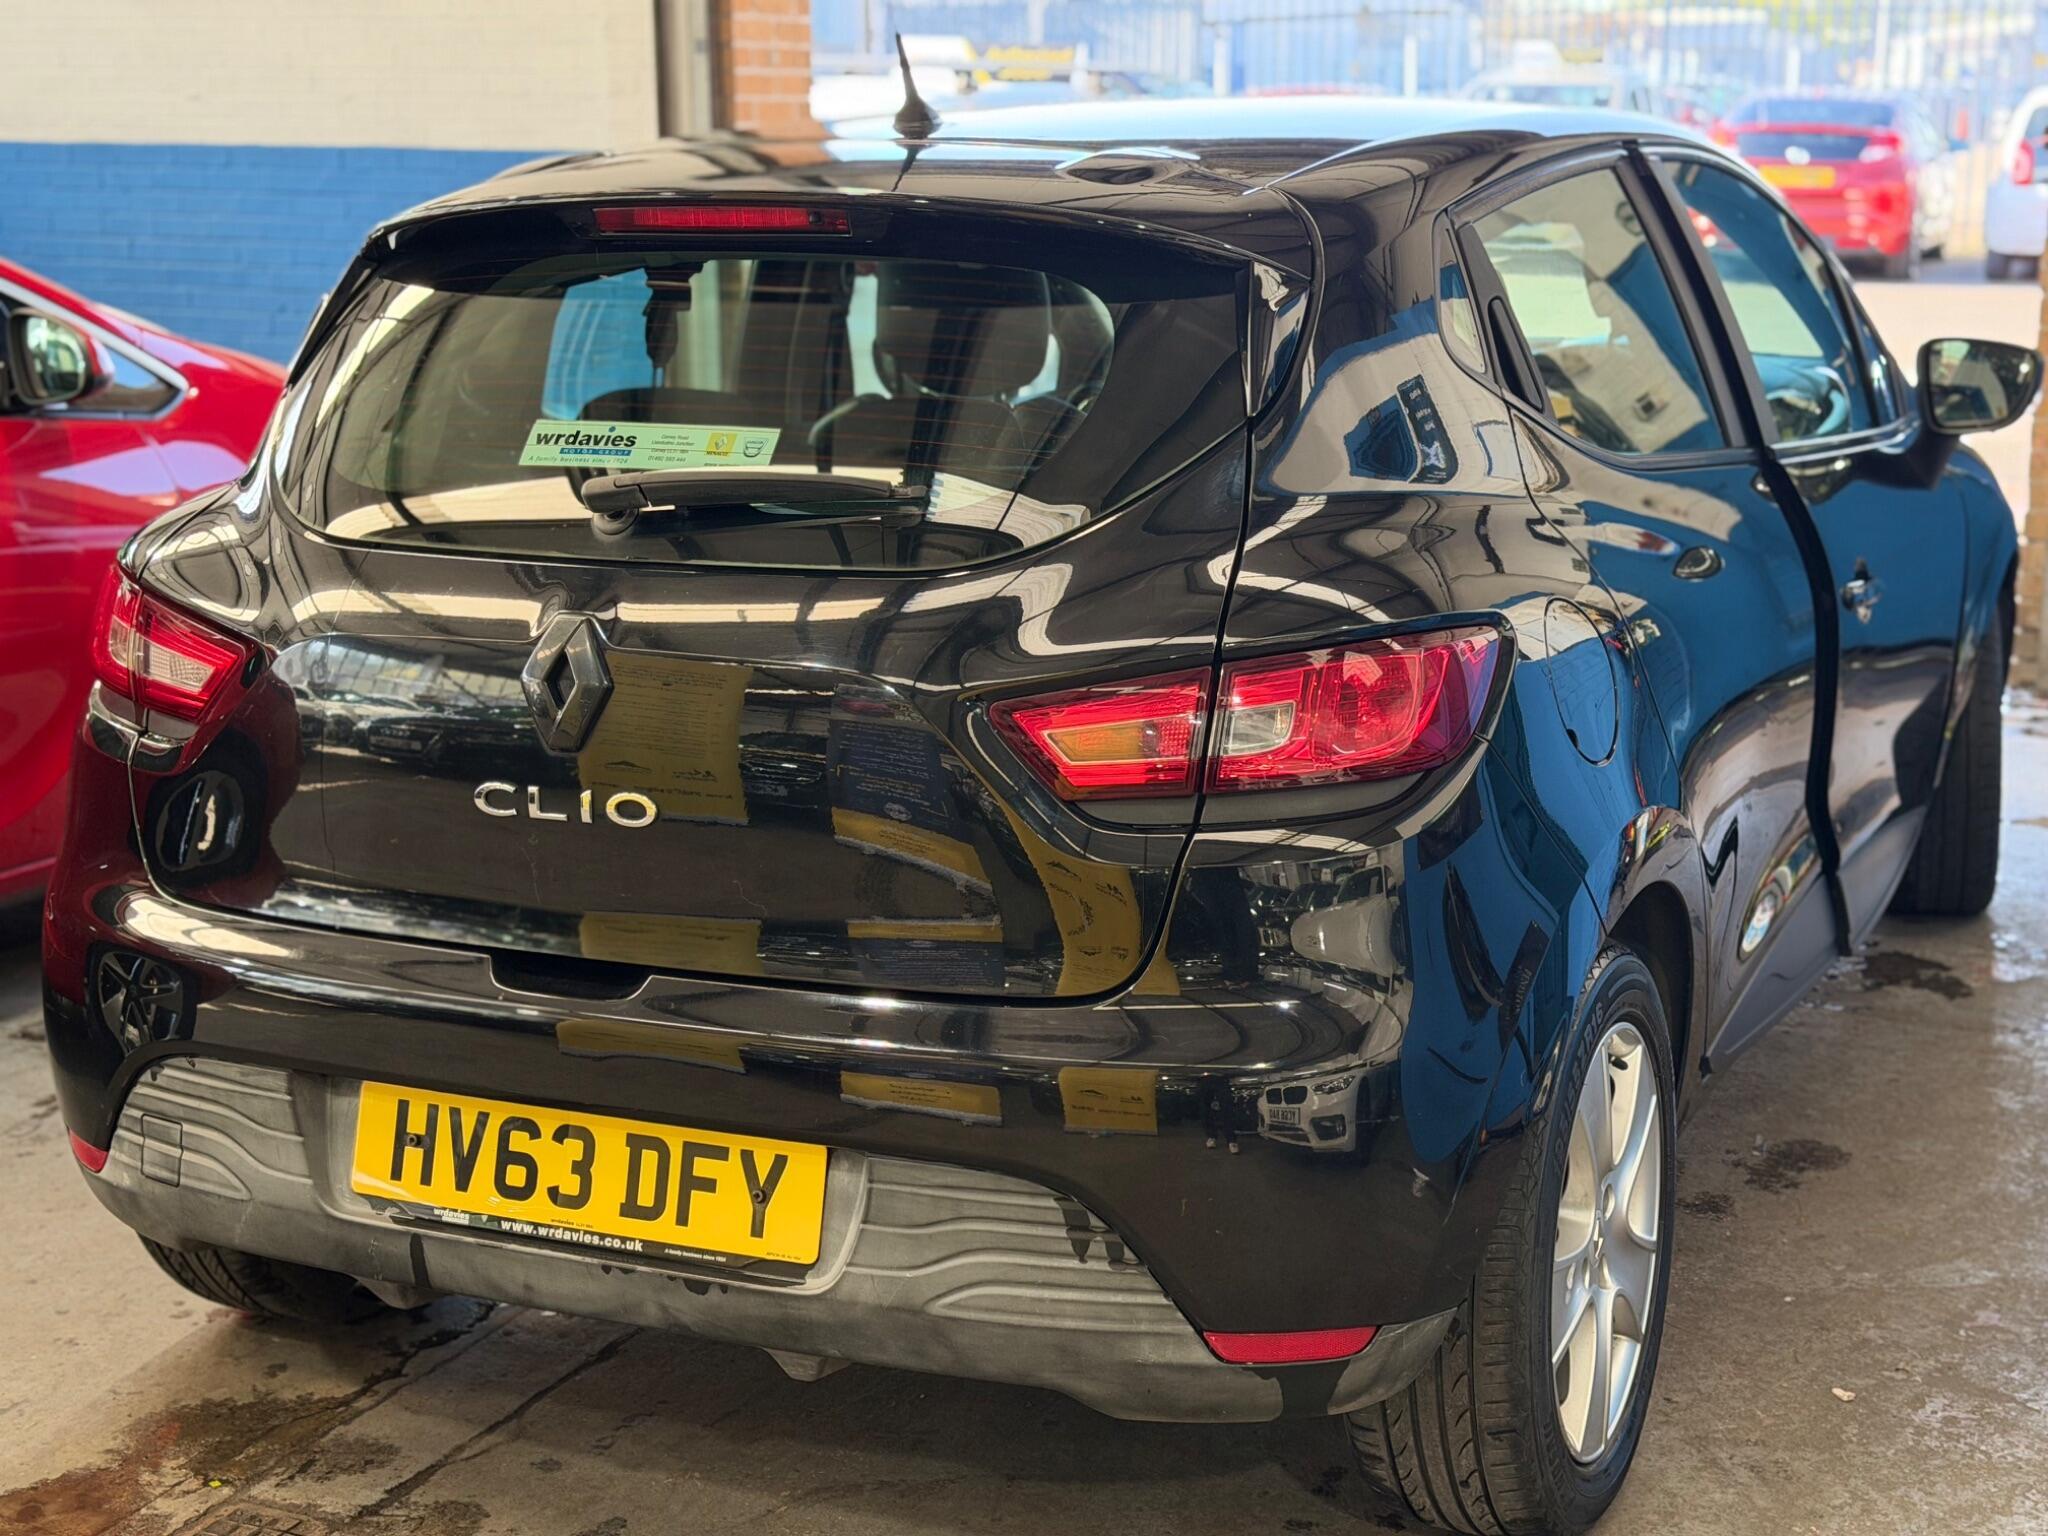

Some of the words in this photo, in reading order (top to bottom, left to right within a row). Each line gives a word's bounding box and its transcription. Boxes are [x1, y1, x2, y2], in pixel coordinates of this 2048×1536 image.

[536, 426, 637, 448] wrdavies
[473, 781, 658, 829] CLIO
[389, 1098, 597, 1211] HV63
[618, 1131, 789, 1240] DFY
[500, 1218, 644, 1253] www.wrdavies.co.uk
